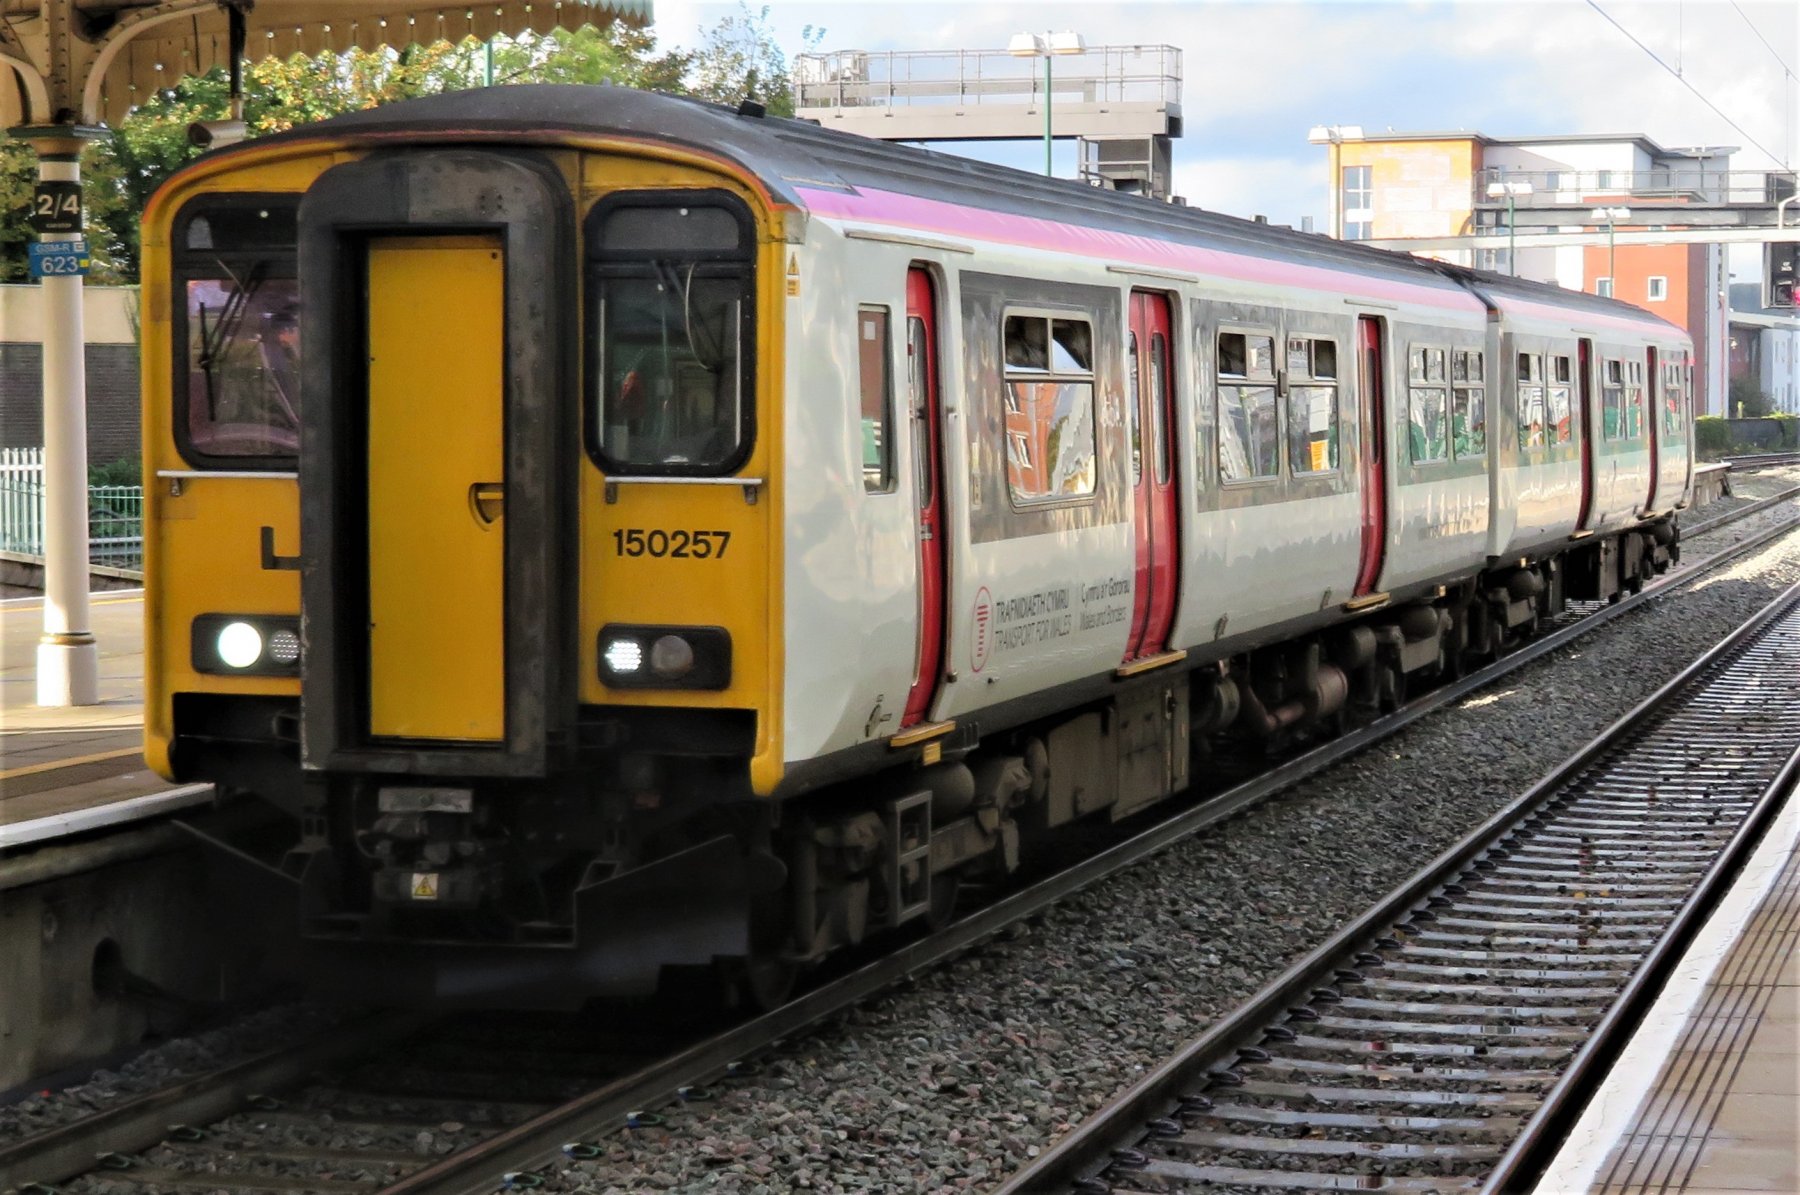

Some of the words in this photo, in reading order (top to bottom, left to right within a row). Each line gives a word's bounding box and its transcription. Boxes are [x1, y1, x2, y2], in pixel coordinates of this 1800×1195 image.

[37, 193, 80, 219] 2/4
[41, 256, 78, 273] 623
[613, 529, 731, 559] 150257
[1046, 588, 1070, 613] CYMRU
[995, 622, 1035, 651] TRANSPORT
[1036, 619, 1049, 642] FOR
[1049, 614, 1072, 638] WALES
